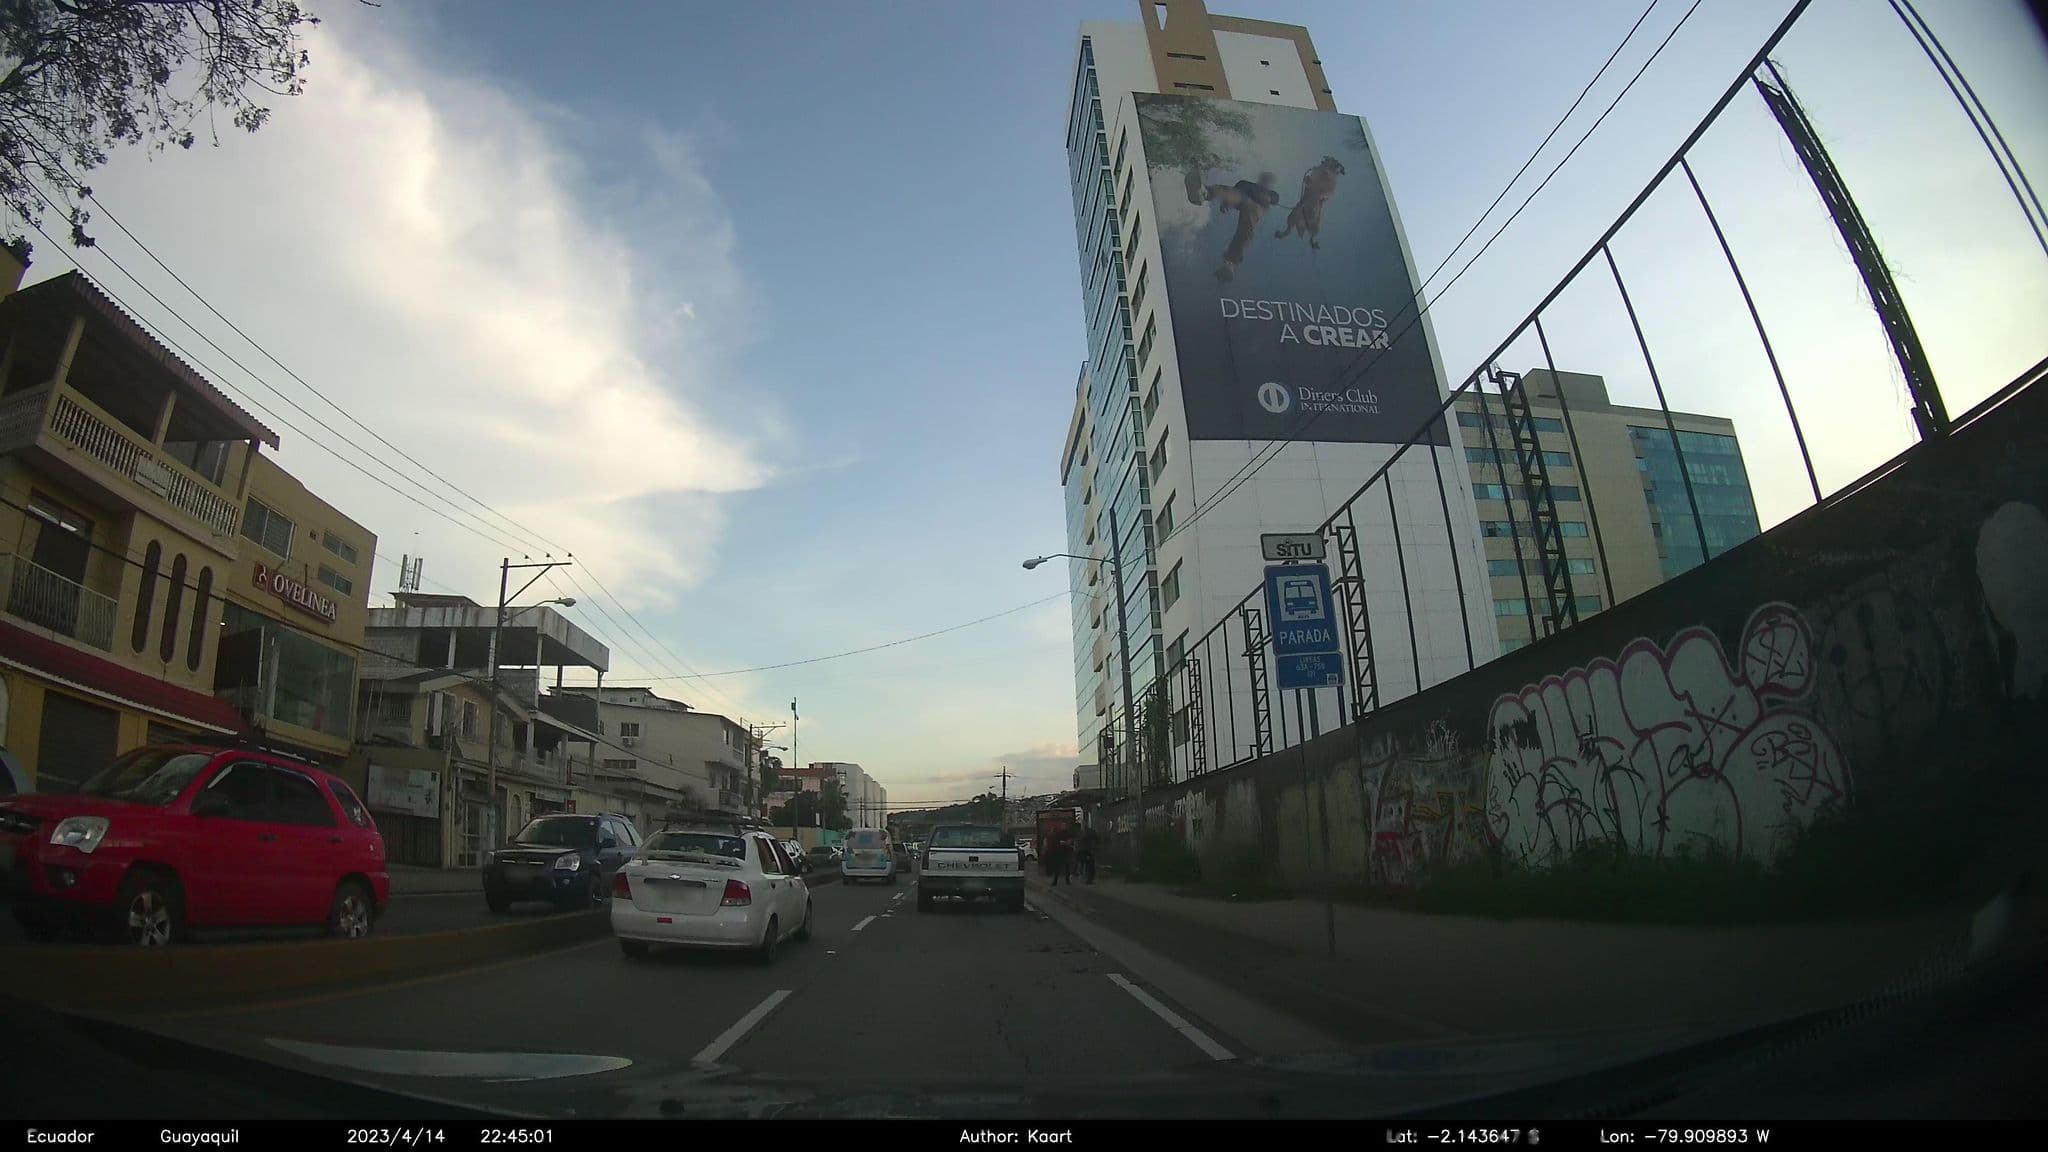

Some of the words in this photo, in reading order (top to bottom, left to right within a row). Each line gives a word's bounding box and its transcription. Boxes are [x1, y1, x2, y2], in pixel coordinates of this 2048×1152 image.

[1219, 297, 1388, 329] DESTINADOS
[1279, 324, 1300, 345] A
[1303, 325, 1392, 351] CREAR
[1298, 386, 1343, 403] Diners
[1345, 388, 1379, 405] Club
[1300, 402, 1382, 415] INTERNATIONAL
[273, 574, 336, 621] OVELINEA
[1279, 628, 1331, 646] PARADA
[937, 862, 1010, 871] CHEVROLET
